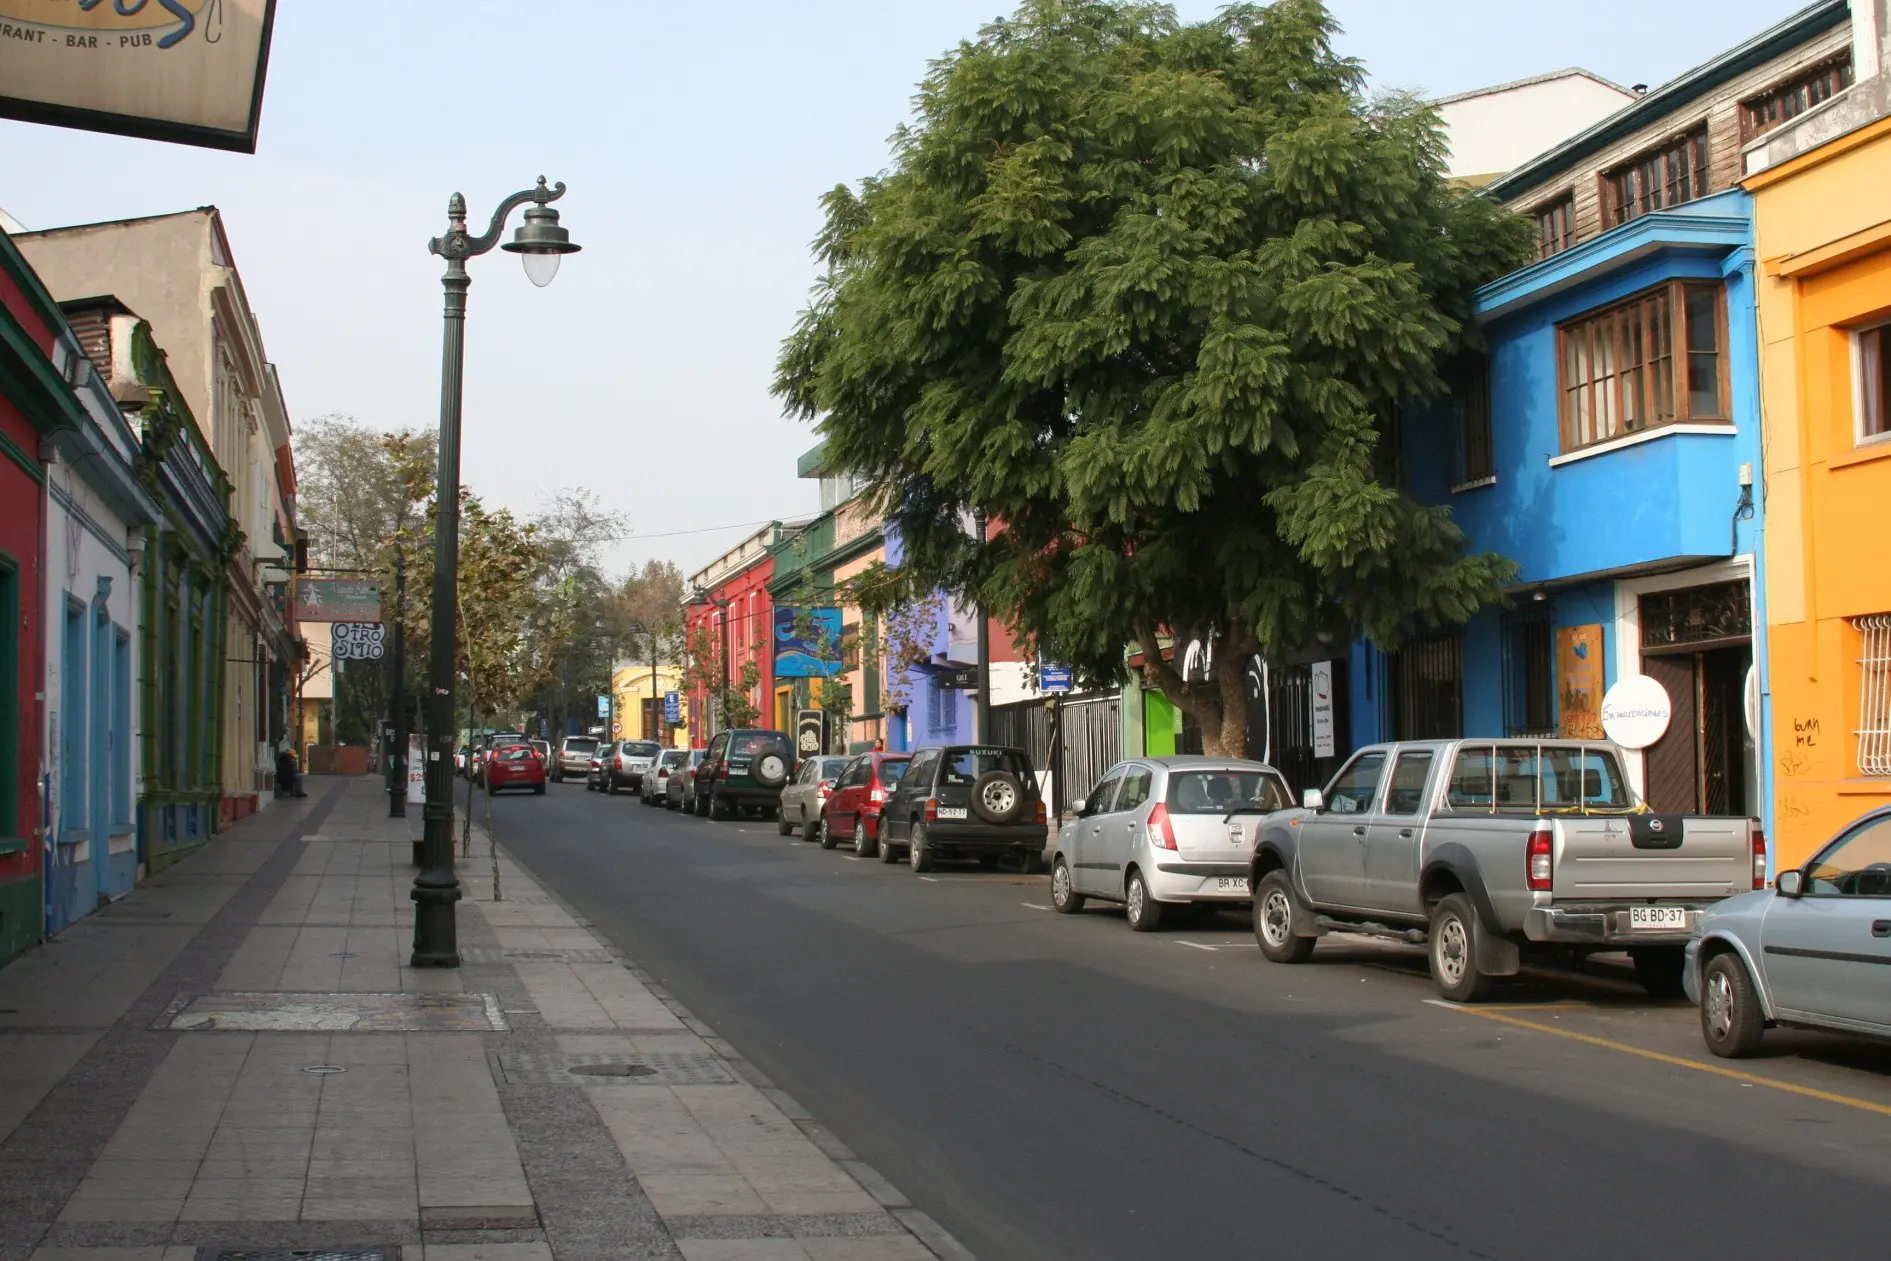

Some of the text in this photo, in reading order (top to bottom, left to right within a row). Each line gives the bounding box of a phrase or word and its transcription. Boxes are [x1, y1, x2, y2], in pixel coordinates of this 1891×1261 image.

[66, 34, 97, 48] BAR
[120, 34, 152, 48] PUB
[335, 623, 380, 645] OTRO
